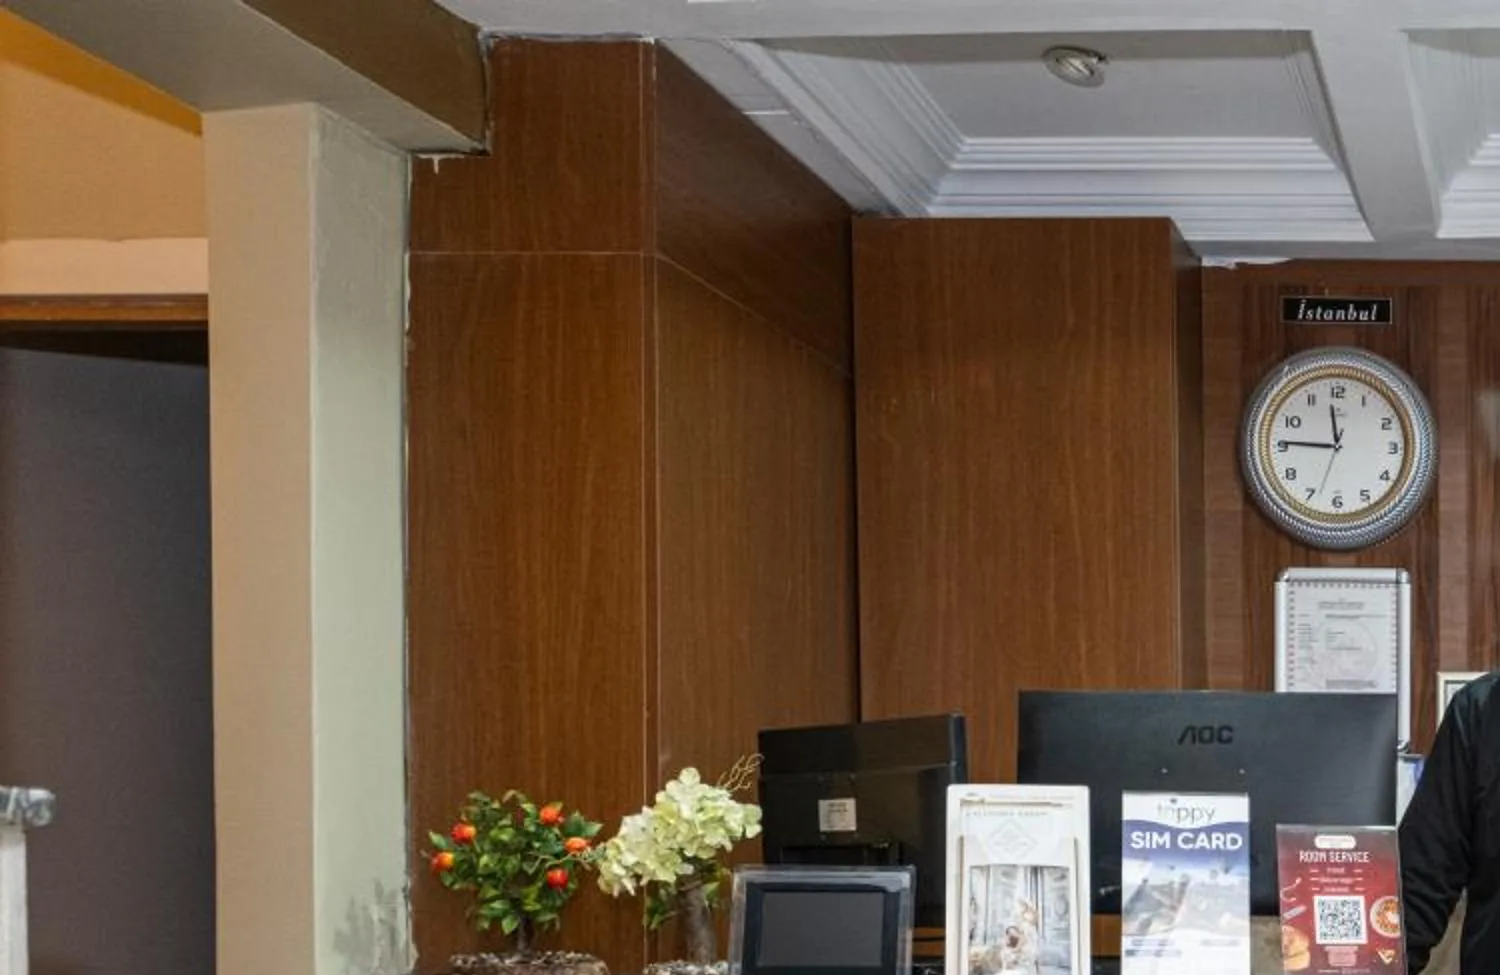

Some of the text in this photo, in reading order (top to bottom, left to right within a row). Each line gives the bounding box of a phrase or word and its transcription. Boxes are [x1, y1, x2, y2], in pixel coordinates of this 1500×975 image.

[1297, 299, 1378, 321] İstanbul
[1330, 386, 1346, 399] 12
[1307, 393, 1316, 406] 11
[1285, 416, 1301, 429] 10
[1381, 418, 1392, 430] 2
[1278, 440, 1288, 452] 9
[1388, 442, 1399, 455] 3
[1285, 468, 1297, 480] 8
[1380, 469, 1390, 481] 4
[1305, 488, 1316, 500] 7
[1360, 490, 1370, 501] 5
[1332, 496, 1343, 508] 6
[1177, 724, 1234, 745] AOC
[1130, 831, 1243, 849] SIM CARD
[1299, 851, 1370, 863] ROOM SERVICE
